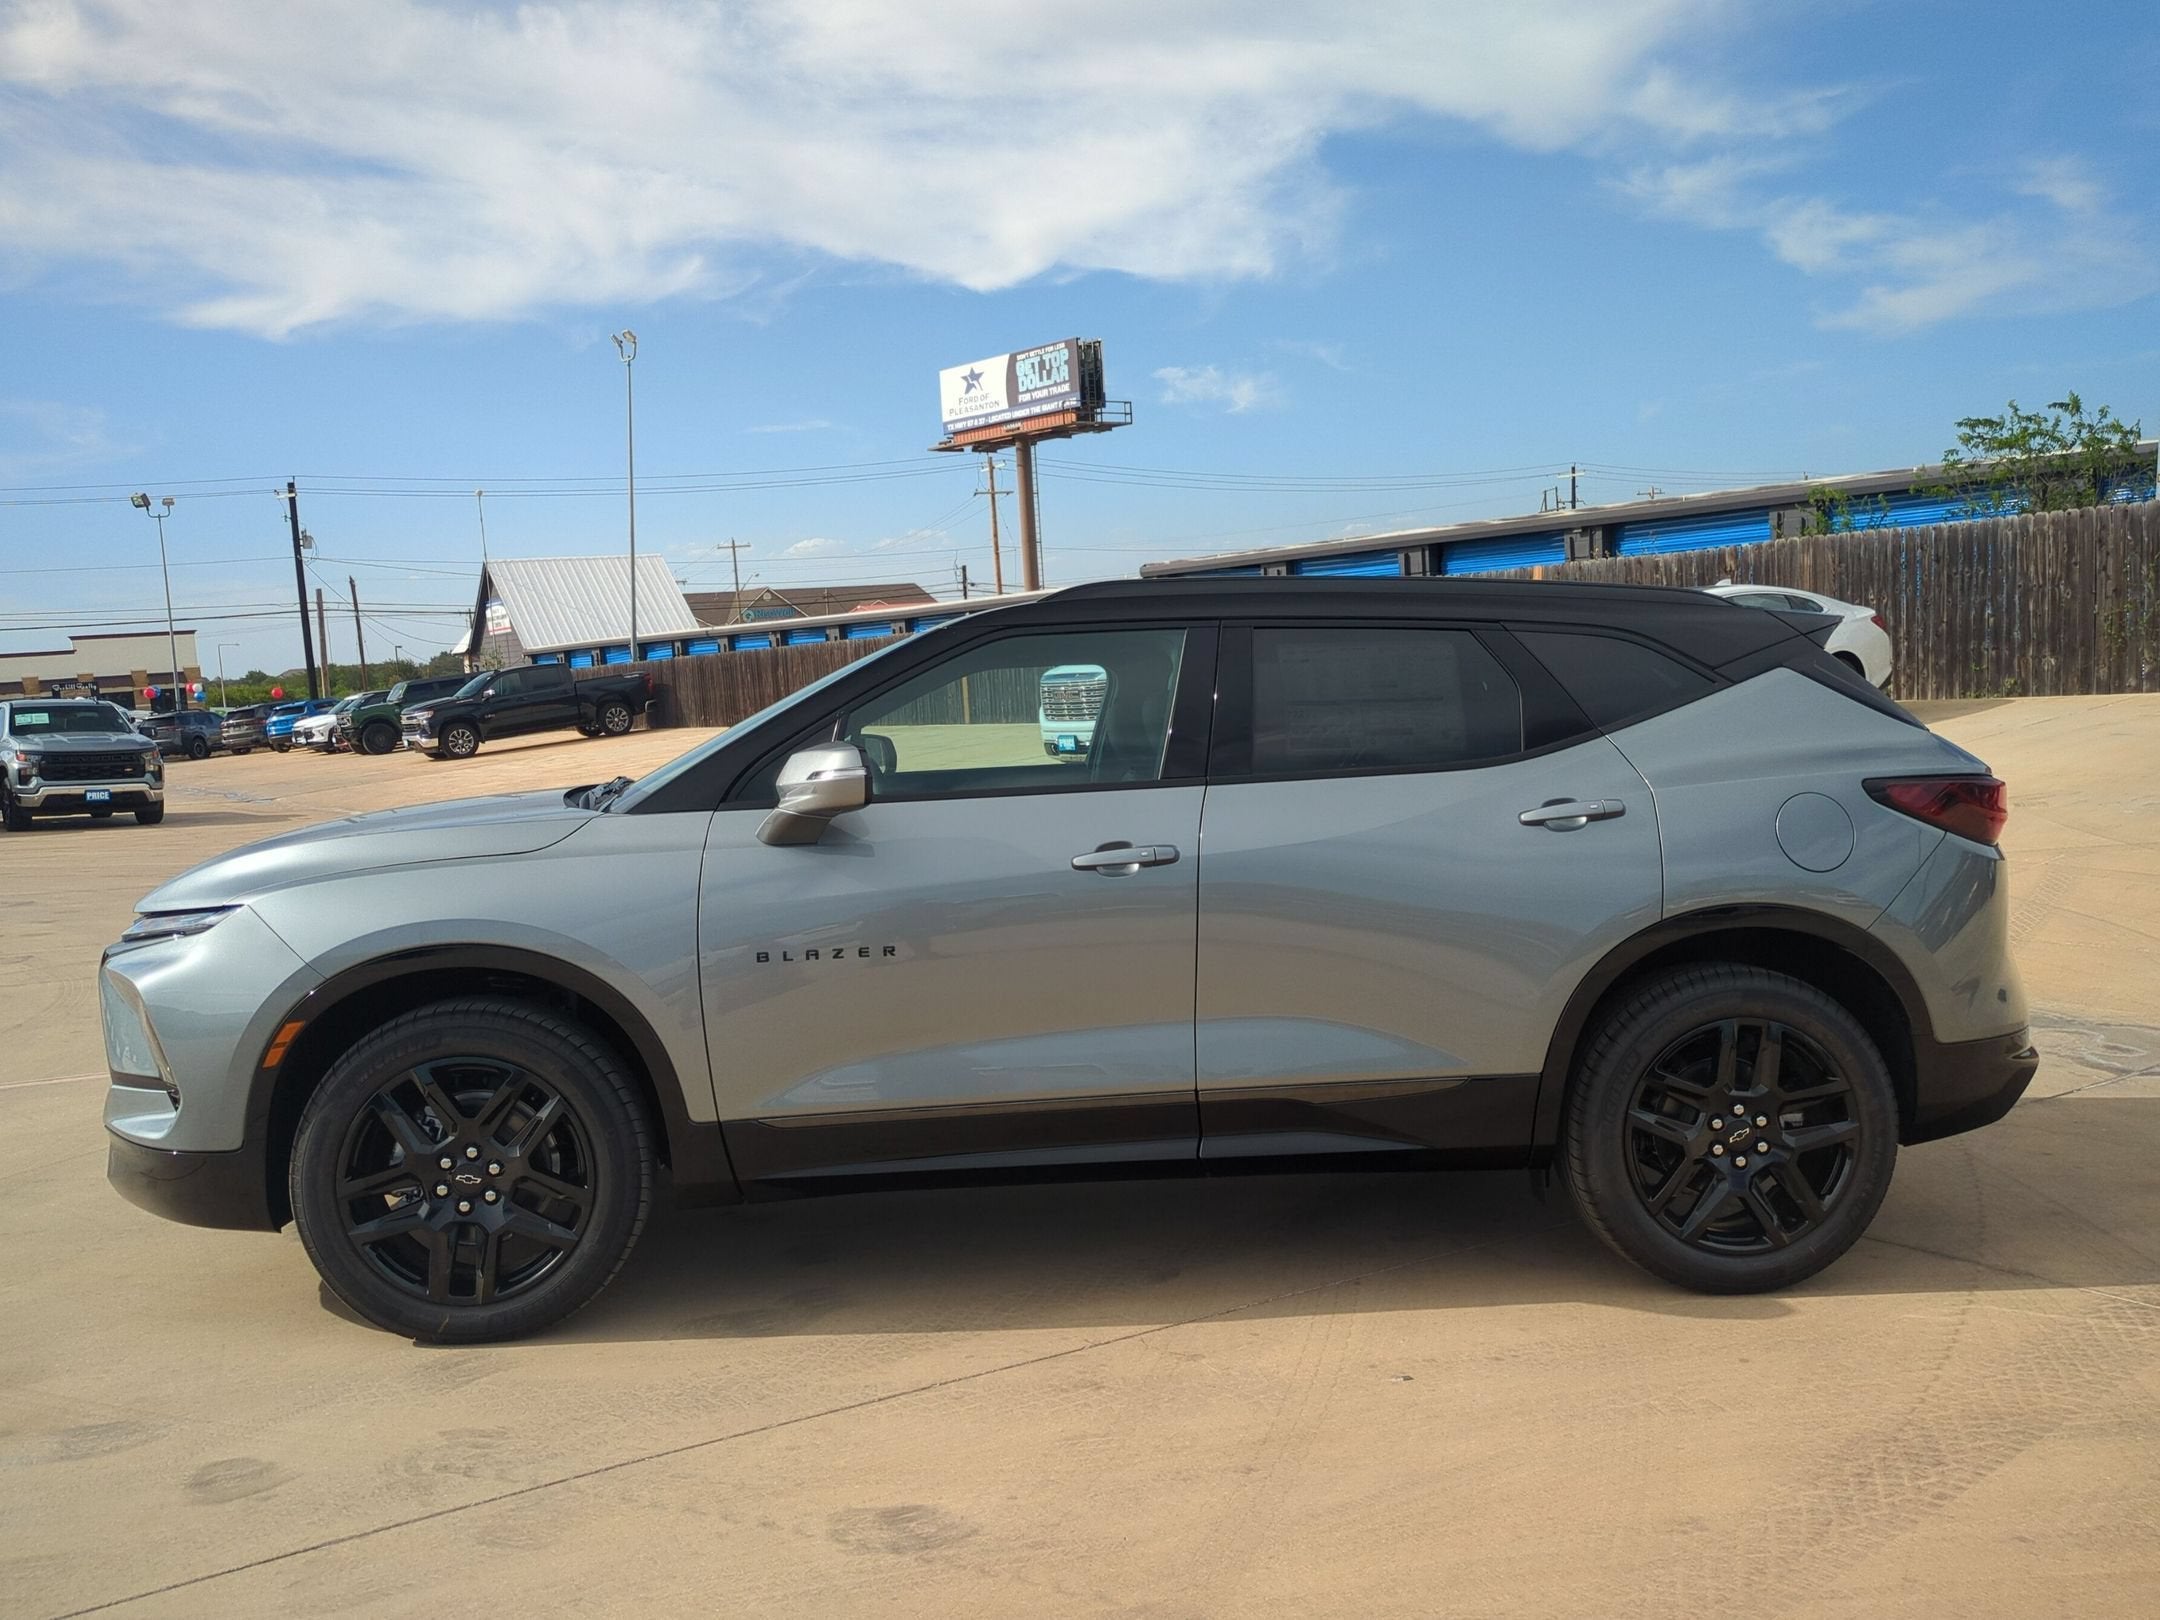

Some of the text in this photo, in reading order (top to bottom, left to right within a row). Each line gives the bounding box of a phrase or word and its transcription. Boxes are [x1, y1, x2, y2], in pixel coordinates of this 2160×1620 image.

[1016, 348, 1069, 377] GET TOP
[1018, 364, 1069, 393] DOLLAR
[959, 392, 990, 406] FORD OF
[1018, 383, 1070, 403] FOR YOUR TRADE
[949, 400, 1000, 416] PLEASANTON
[989, 411, 1011, 424] LOCATED
[1012, 408, 1029, 419] UNDER
[1030, 405, 1040, 415] THE
[86, 791, 110, 801] PRICE
[756, 945, 896, 963] BLAZER
